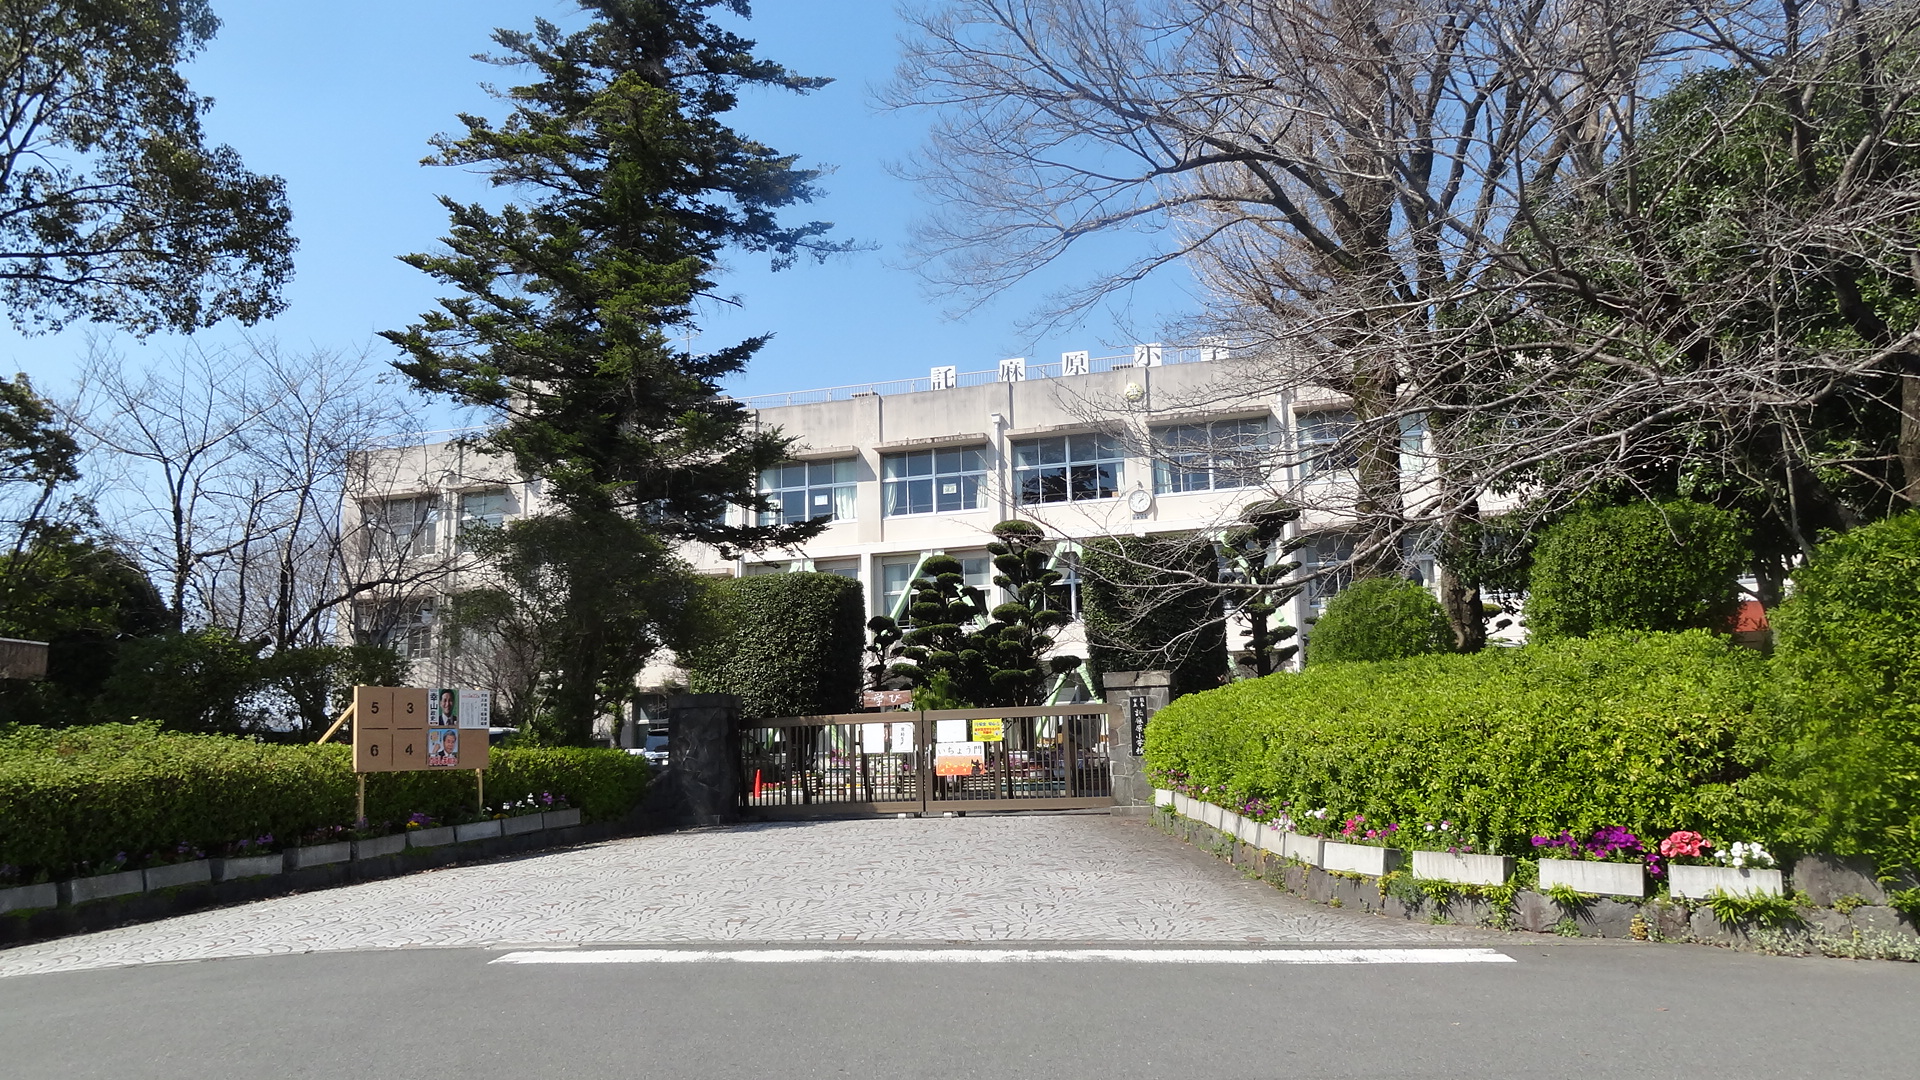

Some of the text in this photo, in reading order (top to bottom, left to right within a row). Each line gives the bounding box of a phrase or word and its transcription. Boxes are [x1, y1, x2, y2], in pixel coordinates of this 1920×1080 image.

[873, 692, 901, 706] 学び
[371, 702, 379, 714] 5
[406, 703, 414, 714] 3
[370, 744, 379, 757] 6
[405, 743, 413, 756] 4
[938, 745, 982, 755] いちょう門
